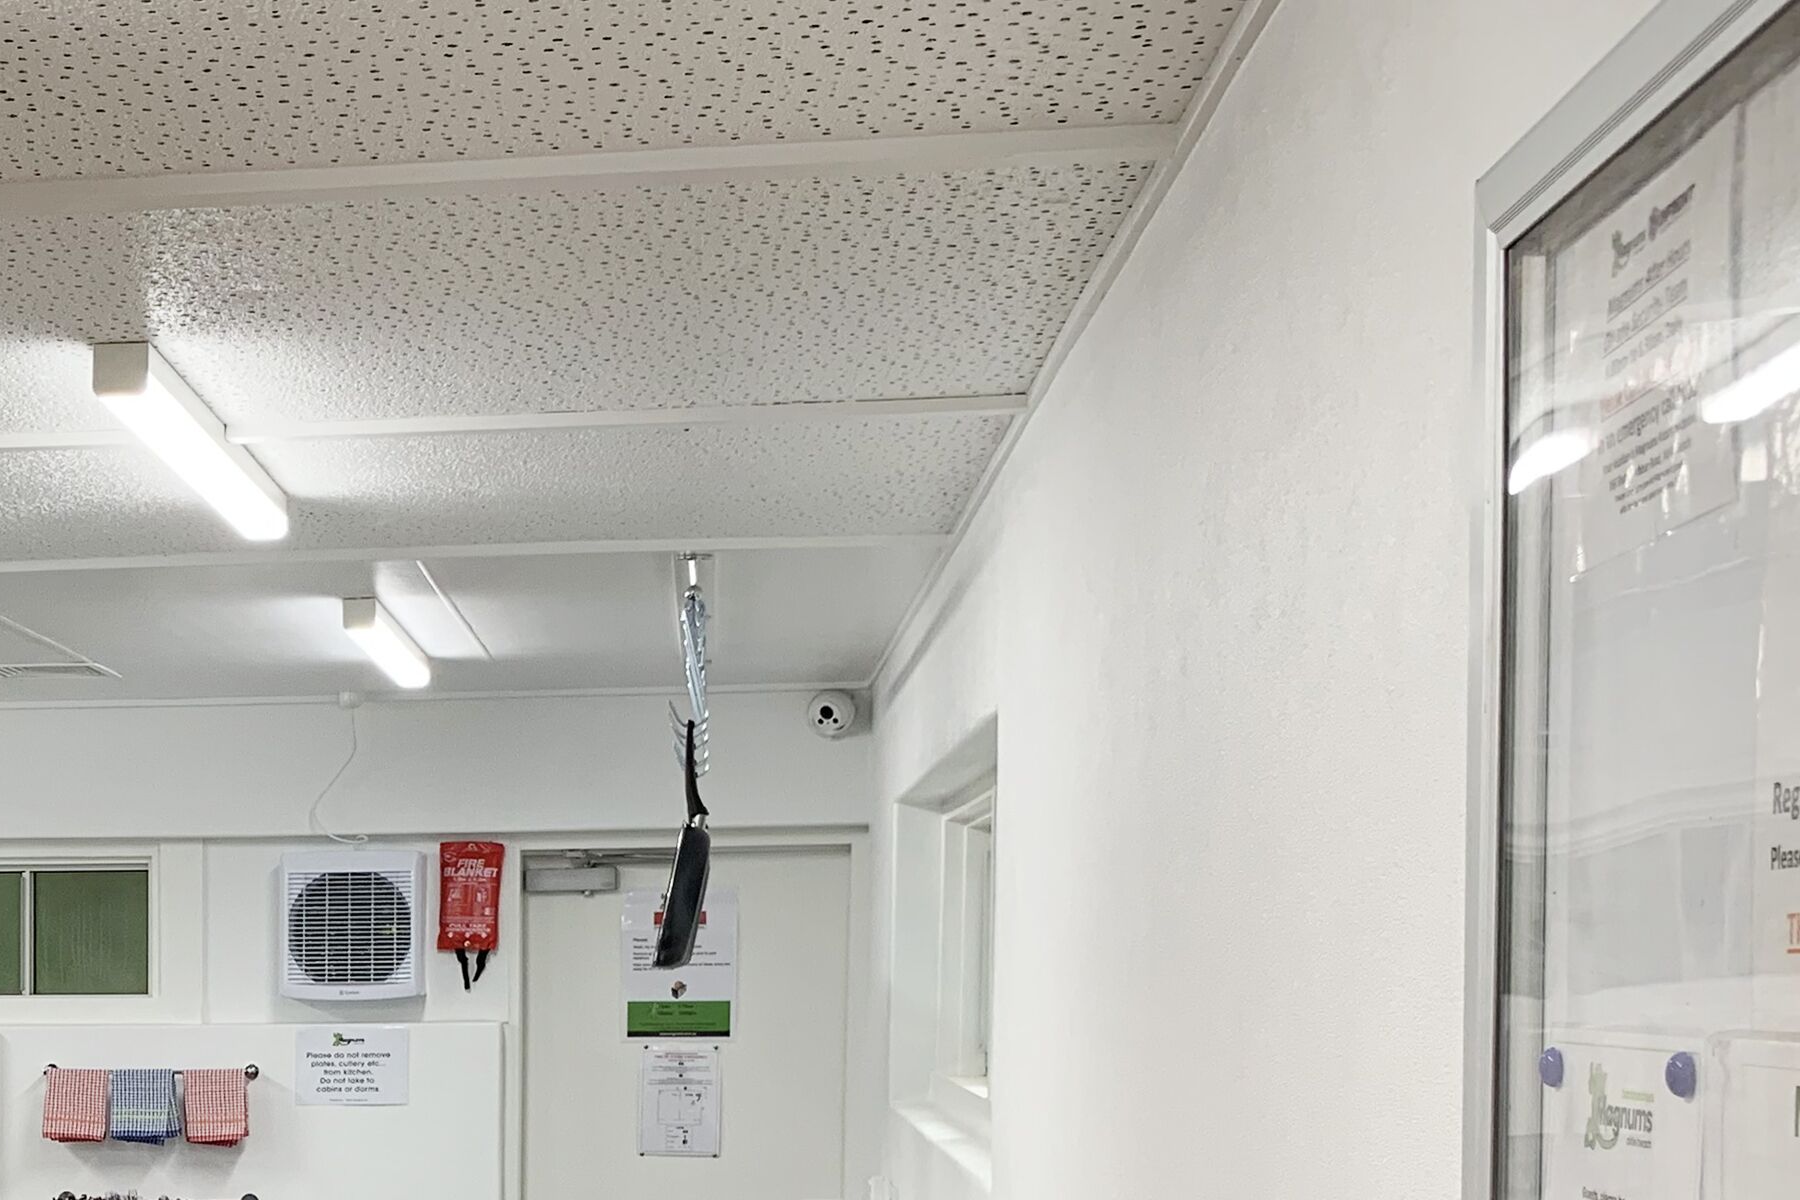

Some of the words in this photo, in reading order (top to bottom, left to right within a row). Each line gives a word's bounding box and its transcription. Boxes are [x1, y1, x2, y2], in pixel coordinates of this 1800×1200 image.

[457, 858, 486, 868] FIRE
[443, 867, 498, 878] BLANKET
[338, 1060, 365, 1068] cutlery
[1596, 1094, 1654, 1137] Magnums
